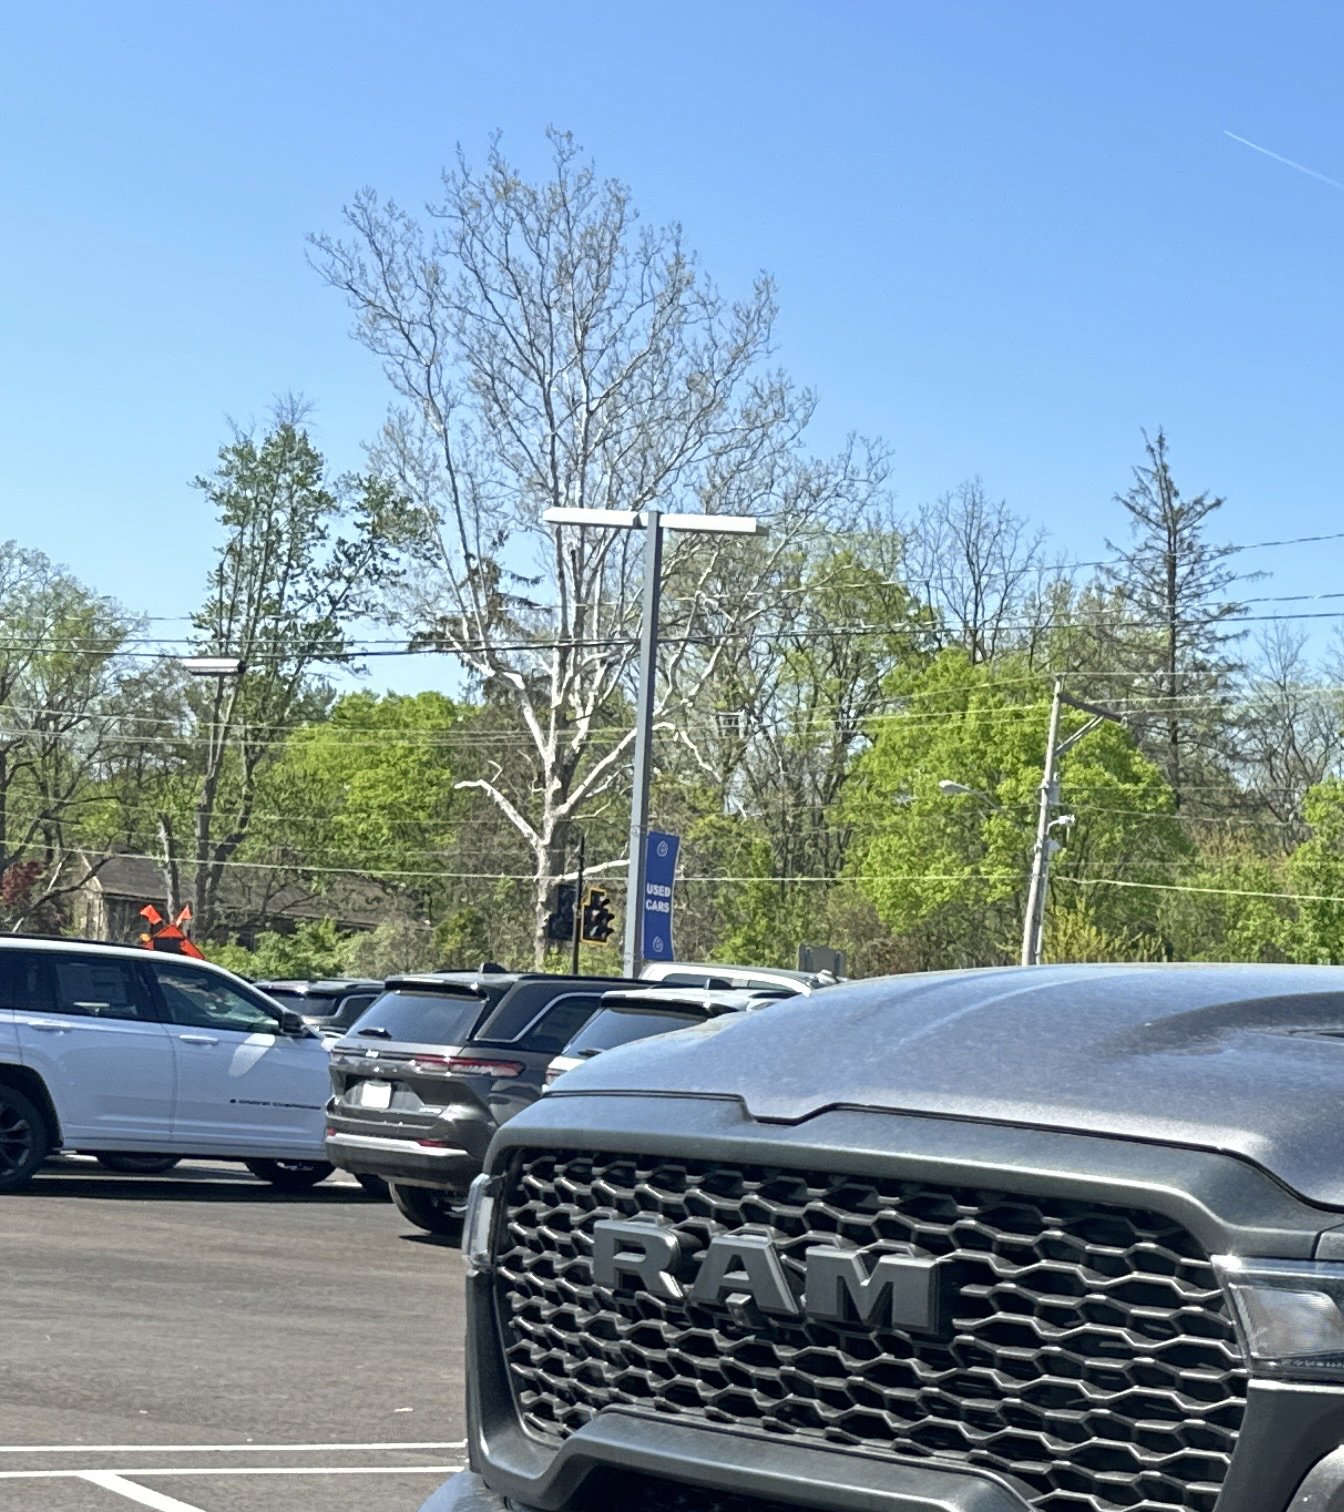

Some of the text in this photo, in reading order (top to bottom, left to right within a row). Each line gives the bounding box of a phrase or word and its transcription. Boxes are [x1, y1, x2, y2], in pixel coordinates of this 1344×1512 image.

[646, 883, 671, 897] USED
[645, 899, 670, 914] CARS
[593, 1219, 941, 1335] RAM
